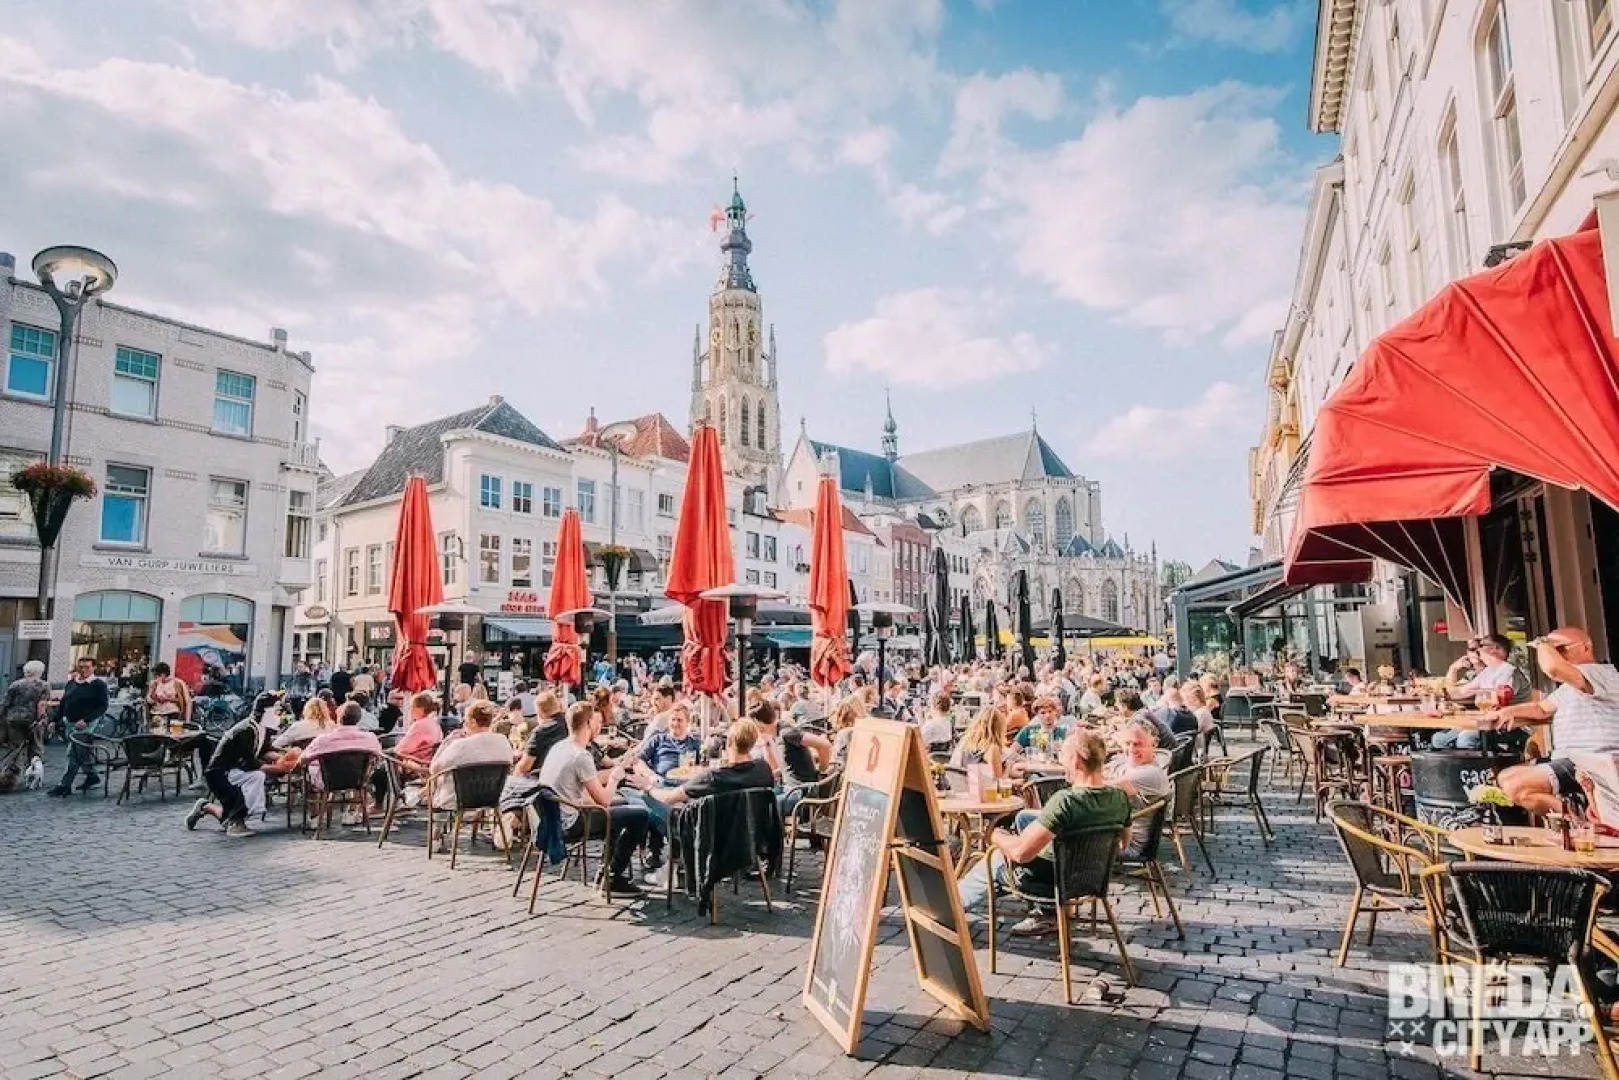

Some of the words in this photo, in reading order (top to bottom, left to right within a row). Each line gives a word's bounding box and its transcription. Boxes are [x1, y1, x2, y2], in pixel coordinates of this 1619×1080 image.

[108, 557, 132, 567] VAN
[138, 560, 170, 569] GURP
[172, 562, 234, 573] JUWELIERS
